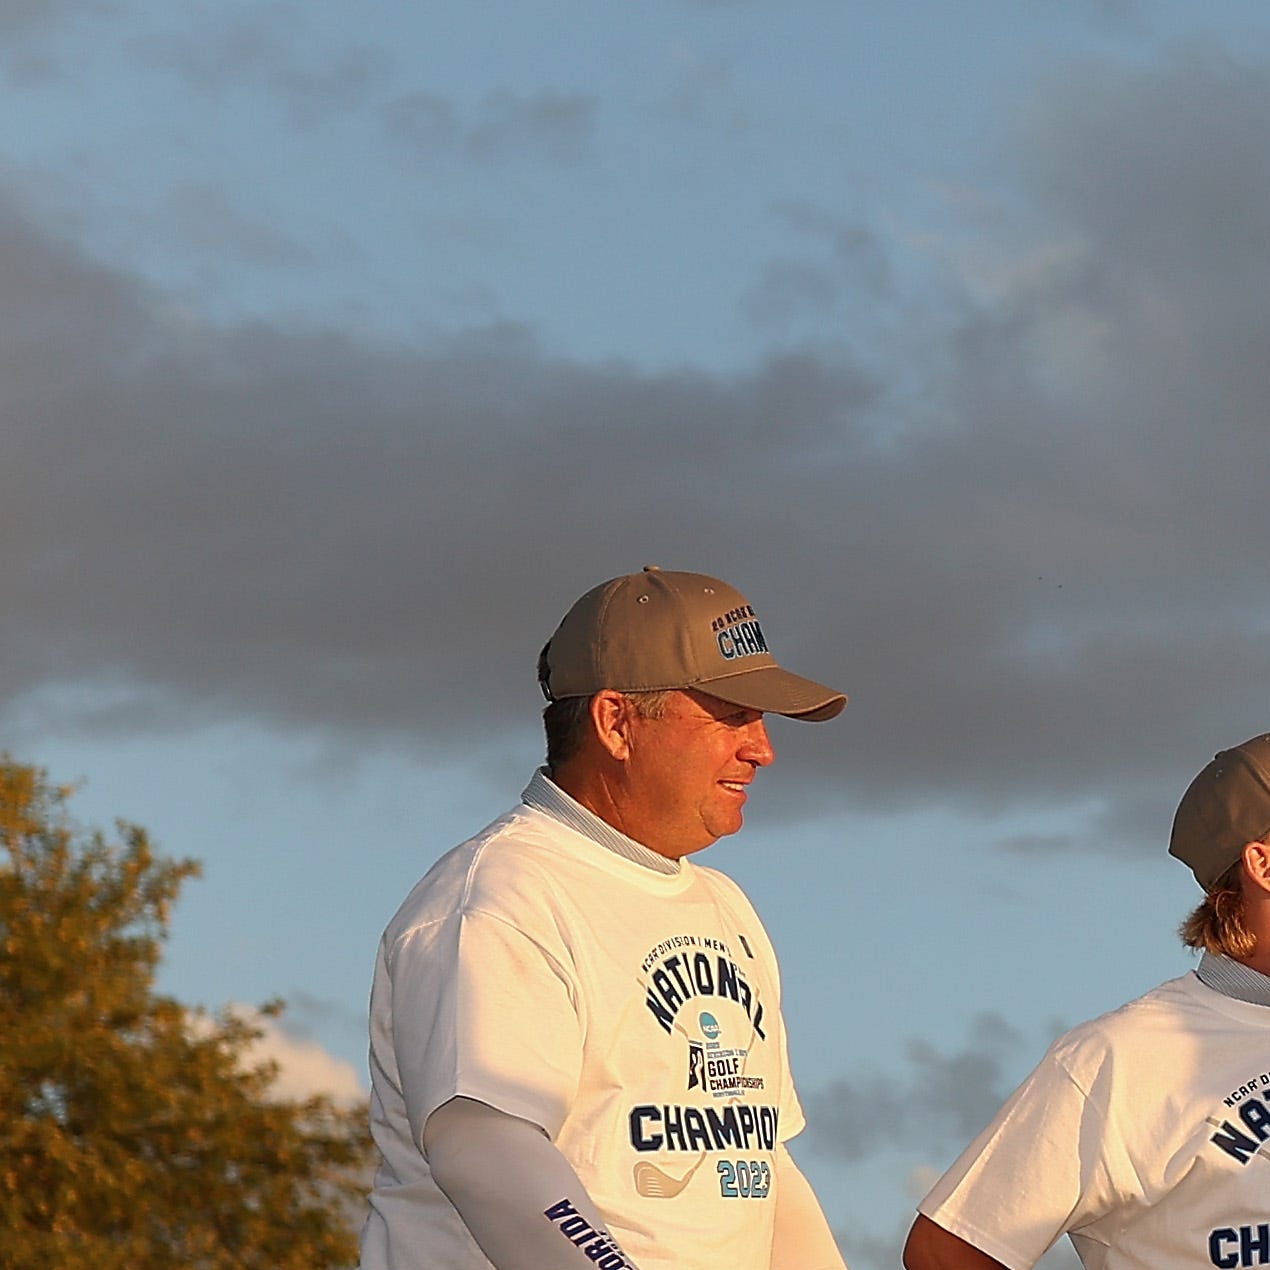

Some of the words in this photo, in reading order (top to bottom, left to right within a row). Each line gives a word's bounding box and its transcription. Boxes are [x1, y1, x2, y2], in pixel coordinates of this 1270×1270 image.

[658, 936, 697, 956] DIVISION
[645, 951, 766, 1042] NATIONAL
[707, 1058, 740, 1077] GOLF
[1223, 1079, 1258, 1108] NCAA
[629, 1103, 779, 1152] CHAMPIO
[715, 1159, 772, 1198] 2023
